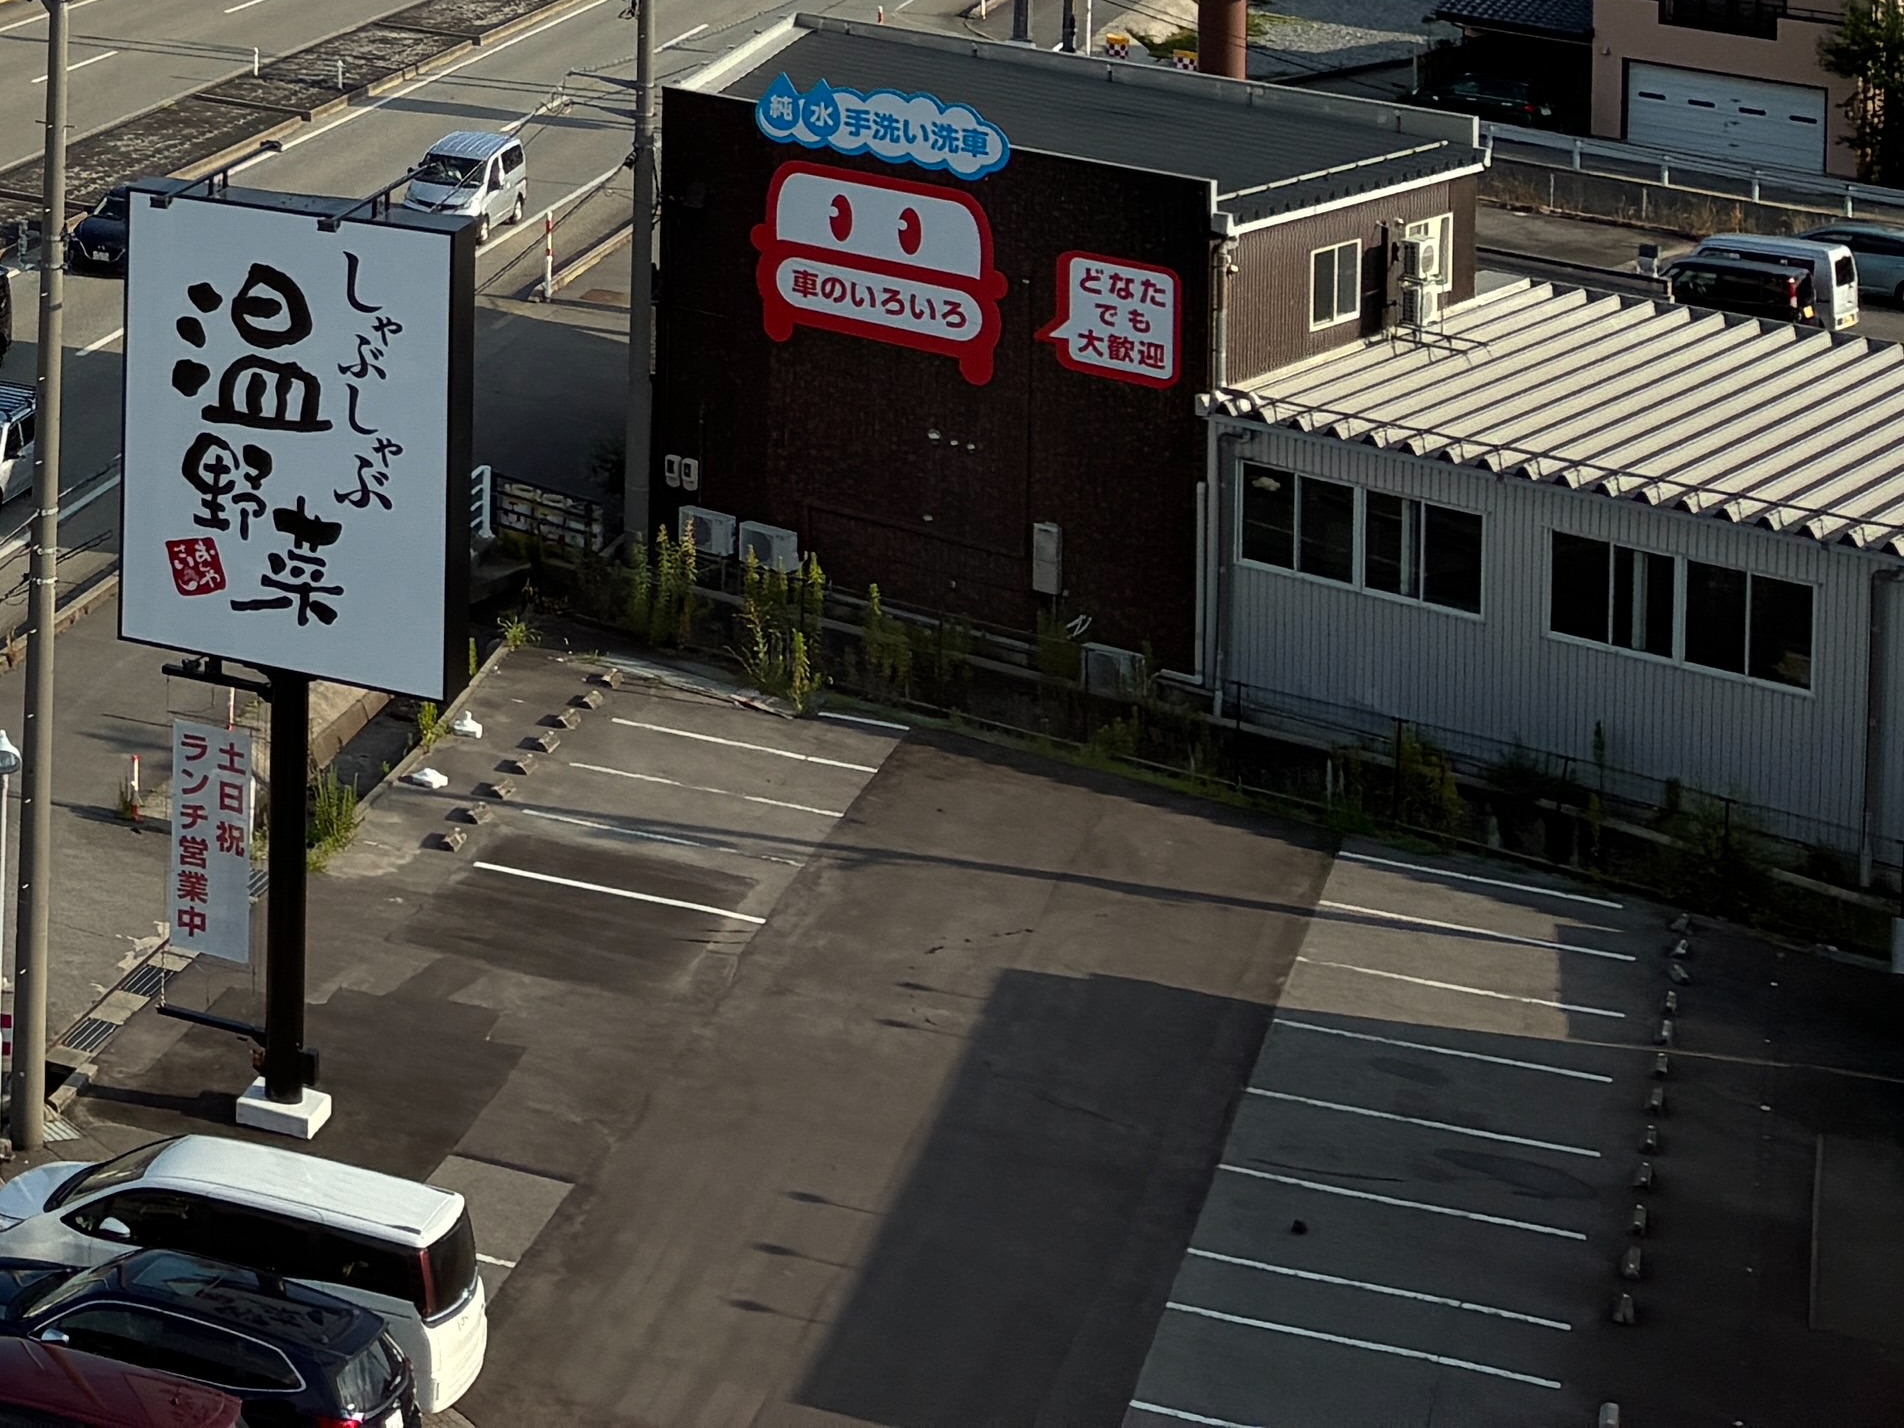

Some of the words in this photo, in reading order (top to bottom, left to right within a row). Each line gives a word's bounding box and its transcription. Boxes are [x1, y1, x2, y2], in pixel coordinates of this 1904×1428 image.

[792, 269, 967, 329] 車のいろいろ
[1079, 267, 1167, 308] どなた
[1095, 303, 1151, 334] でも
[333, 251, 404, 511] しゃぶしゃぶ
[1078, 329, 1166, 370] 大歓迎
[171, 262, 344, 627] 温野菜
[177, 733, 209, 938] ランチ営業中
[216, 742, 246, 858] 土日祝
